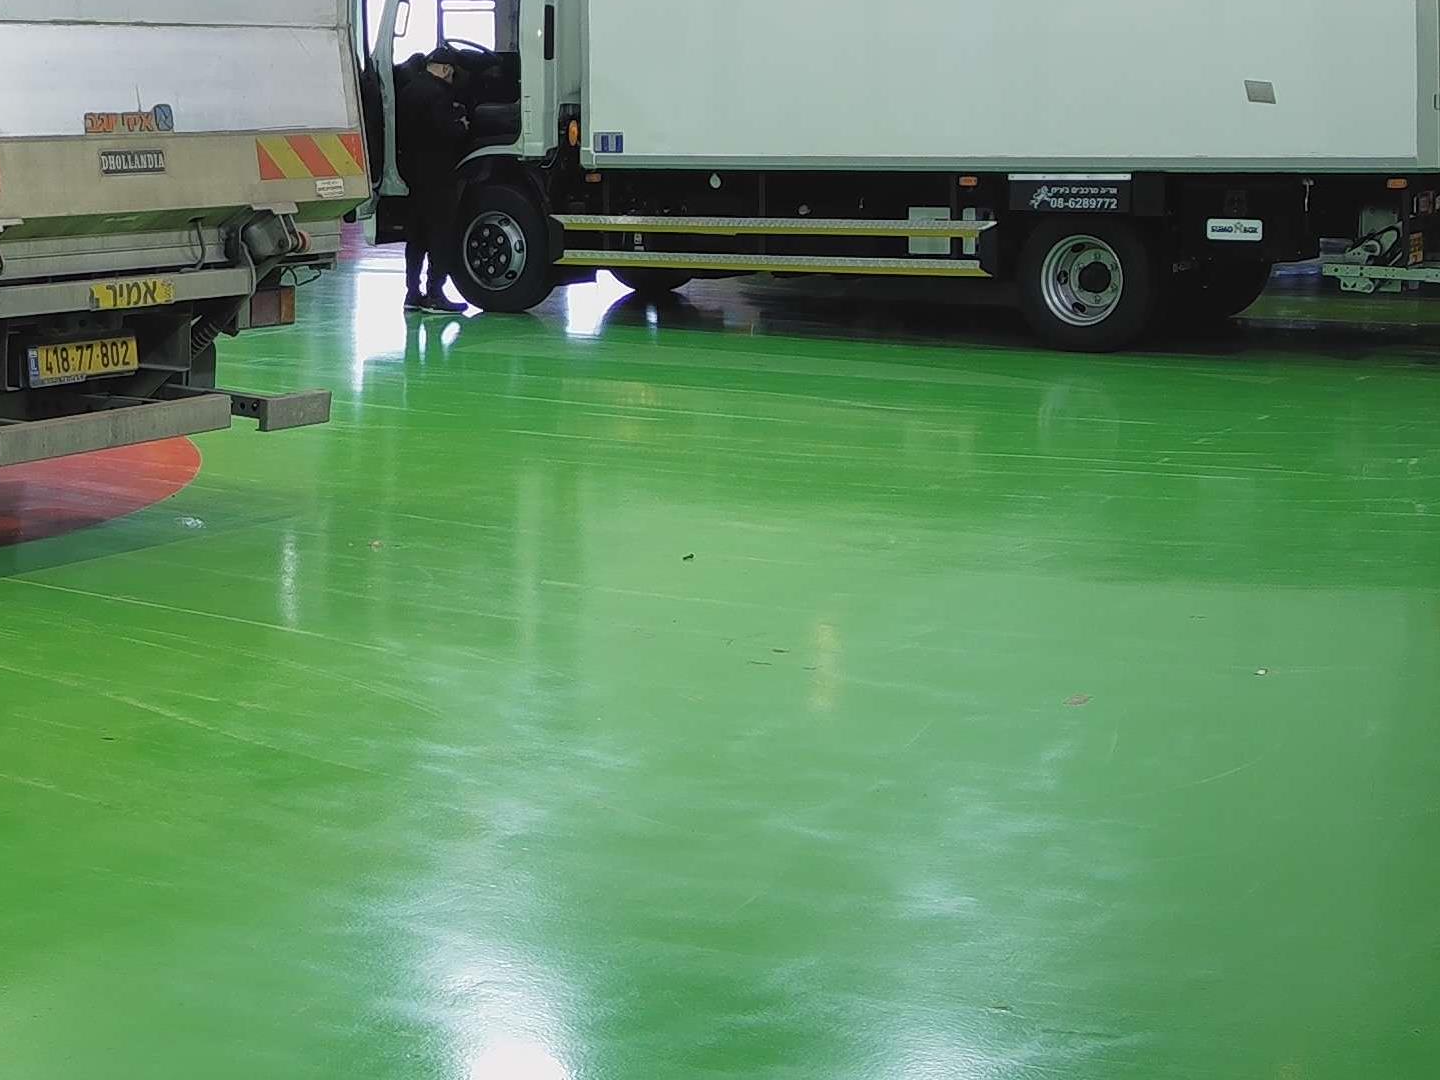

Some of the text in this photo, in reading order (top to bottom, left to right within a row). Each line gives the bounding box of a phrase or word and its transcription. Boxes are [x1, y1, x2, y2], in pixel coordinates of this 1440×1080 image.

[101, 153, 164, 170] DHOLLANDIA
[1050, 197, 1118, 209] 08-6289772
[106, 281, 158, 307] אמיר
